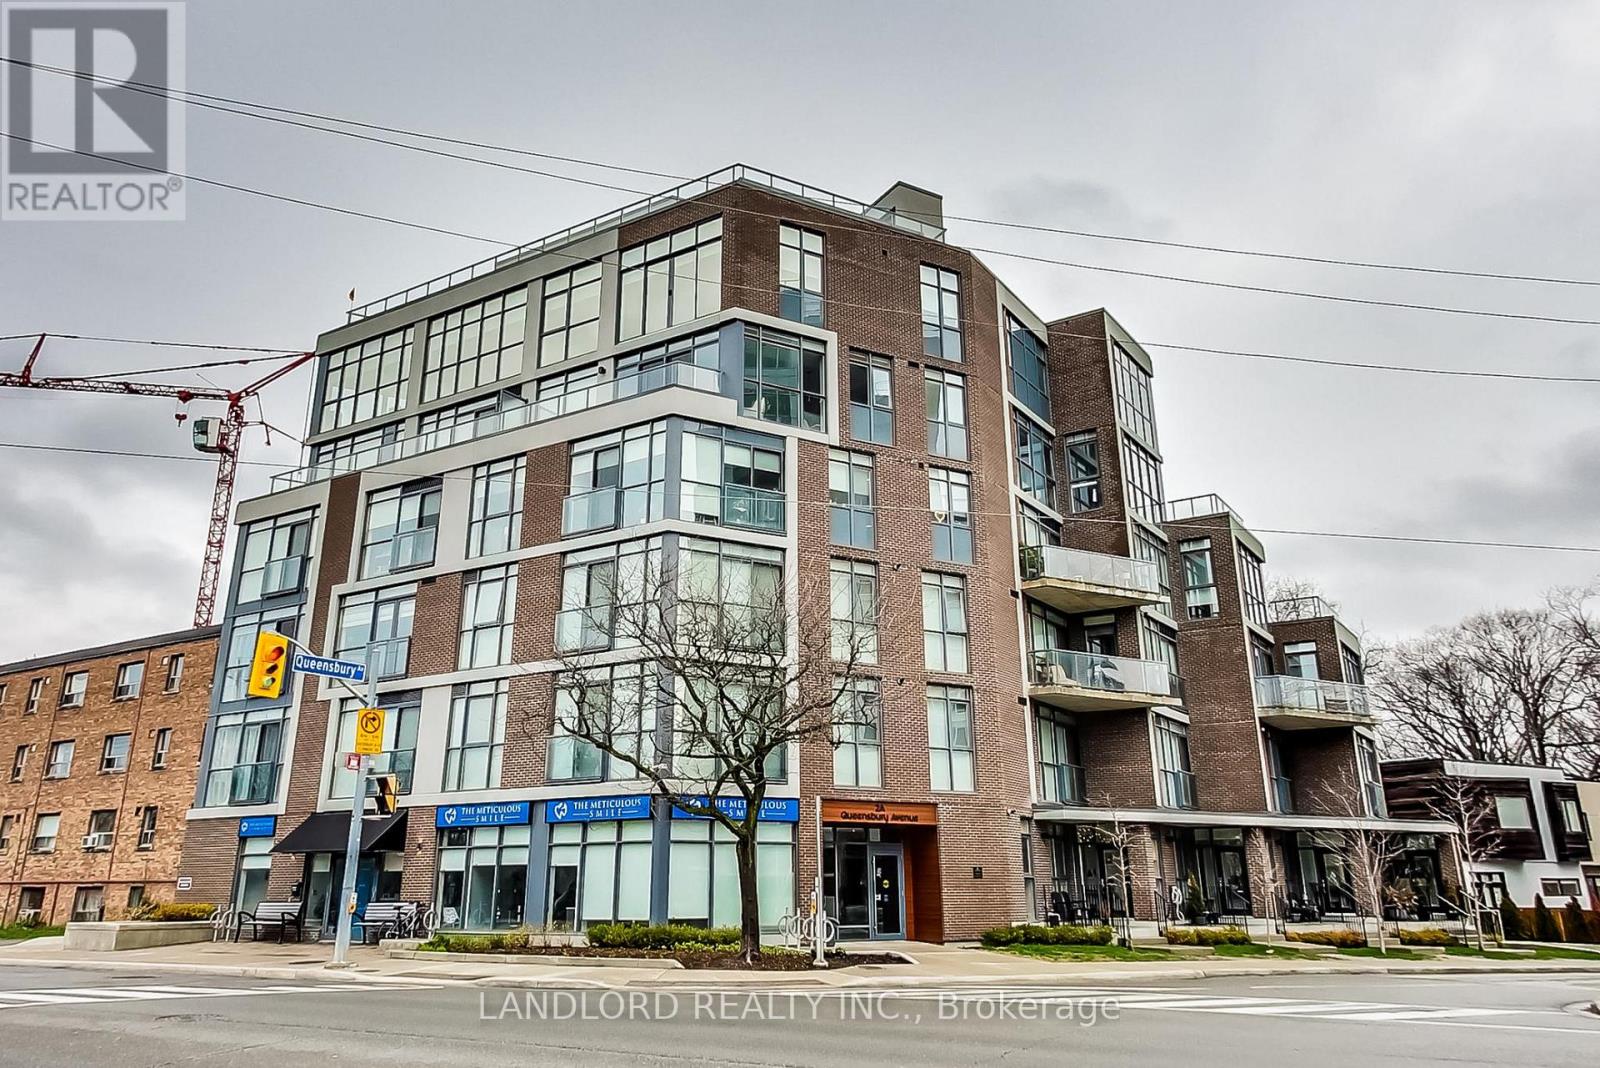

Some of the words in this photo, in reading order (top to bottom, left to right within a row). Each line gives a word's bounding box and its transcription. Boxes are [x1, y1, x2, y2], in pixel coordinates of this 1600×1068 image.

[295, 655, 356, 679] Queensbury
[573, 801, 588, 810] THE
[590, 798, 641, 809] METICULOUS
[729, 800, 787, 810] METLOUS
[875, 803, 886, 813] 2A
[461, 807, 475, 815] THE
[476, 804, 521, 815] METICULOUS
[589, 808, 622, 818] SMILE
[728, 808, 766, 818] SME
[475, 813, 504, 823] SMILE
[840, 810, 889, 824] Queensbury
[891, 813, 919, 823] Avenue
